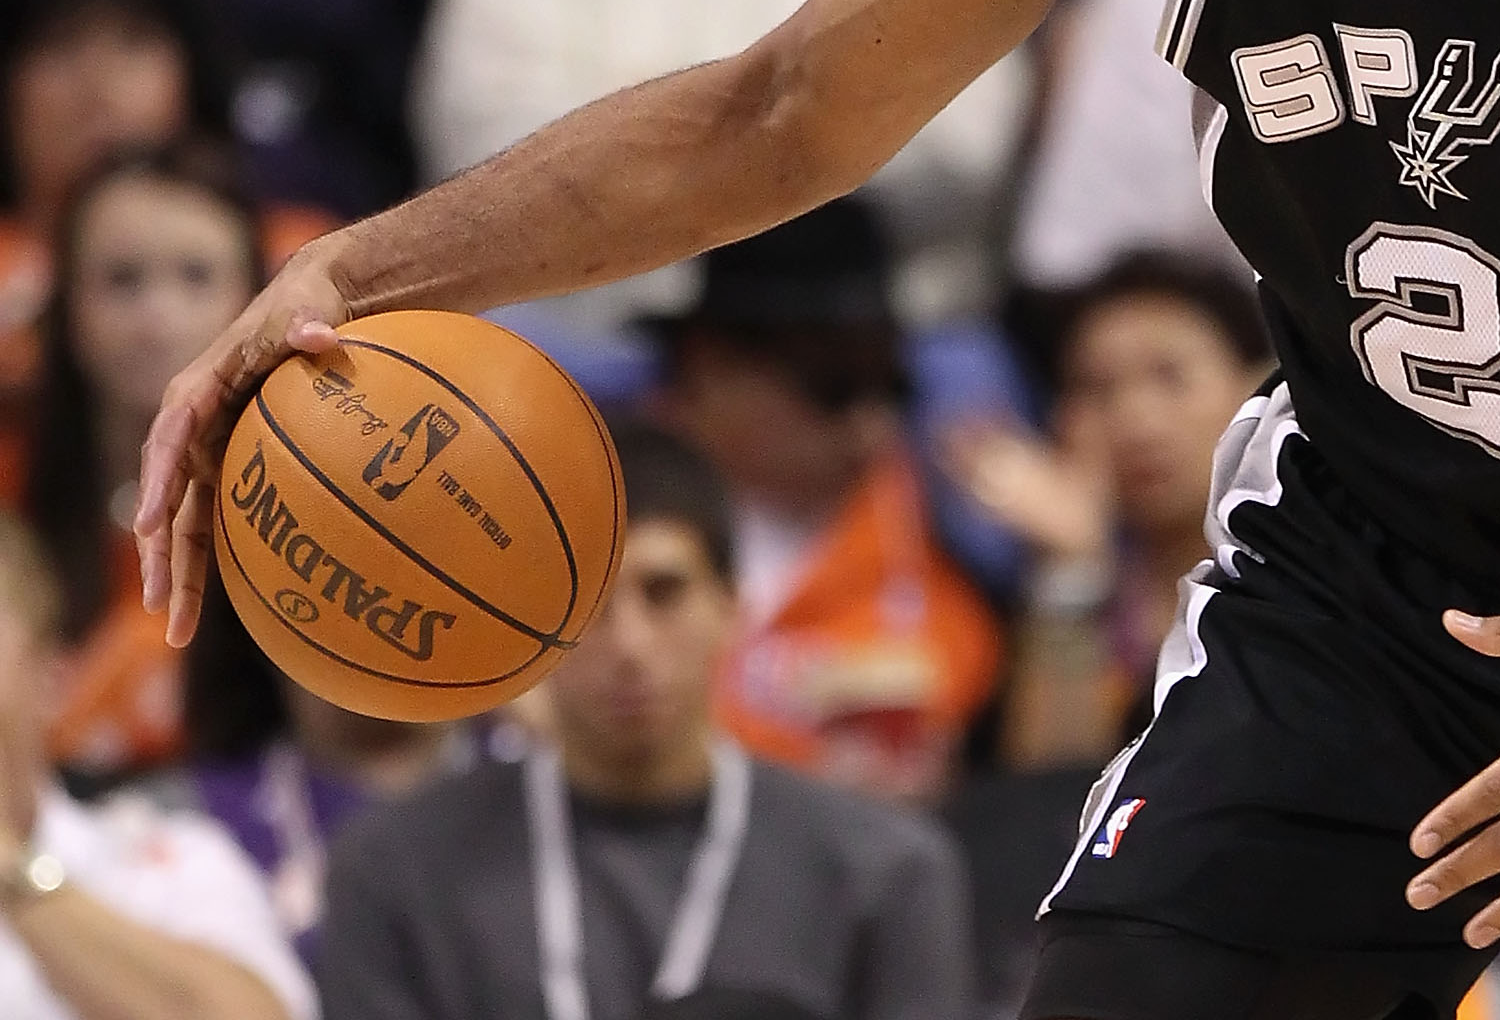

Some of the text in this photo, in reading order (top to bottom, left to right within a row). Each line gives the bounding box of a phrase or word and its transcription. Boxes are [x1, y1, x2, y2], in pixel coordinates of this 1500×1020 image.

[431, 413, 458, 438] NBA
[230, 438, 458, 661] SPALDING
[435, 469, 513, 550] OFFICIAL GAME BALL
